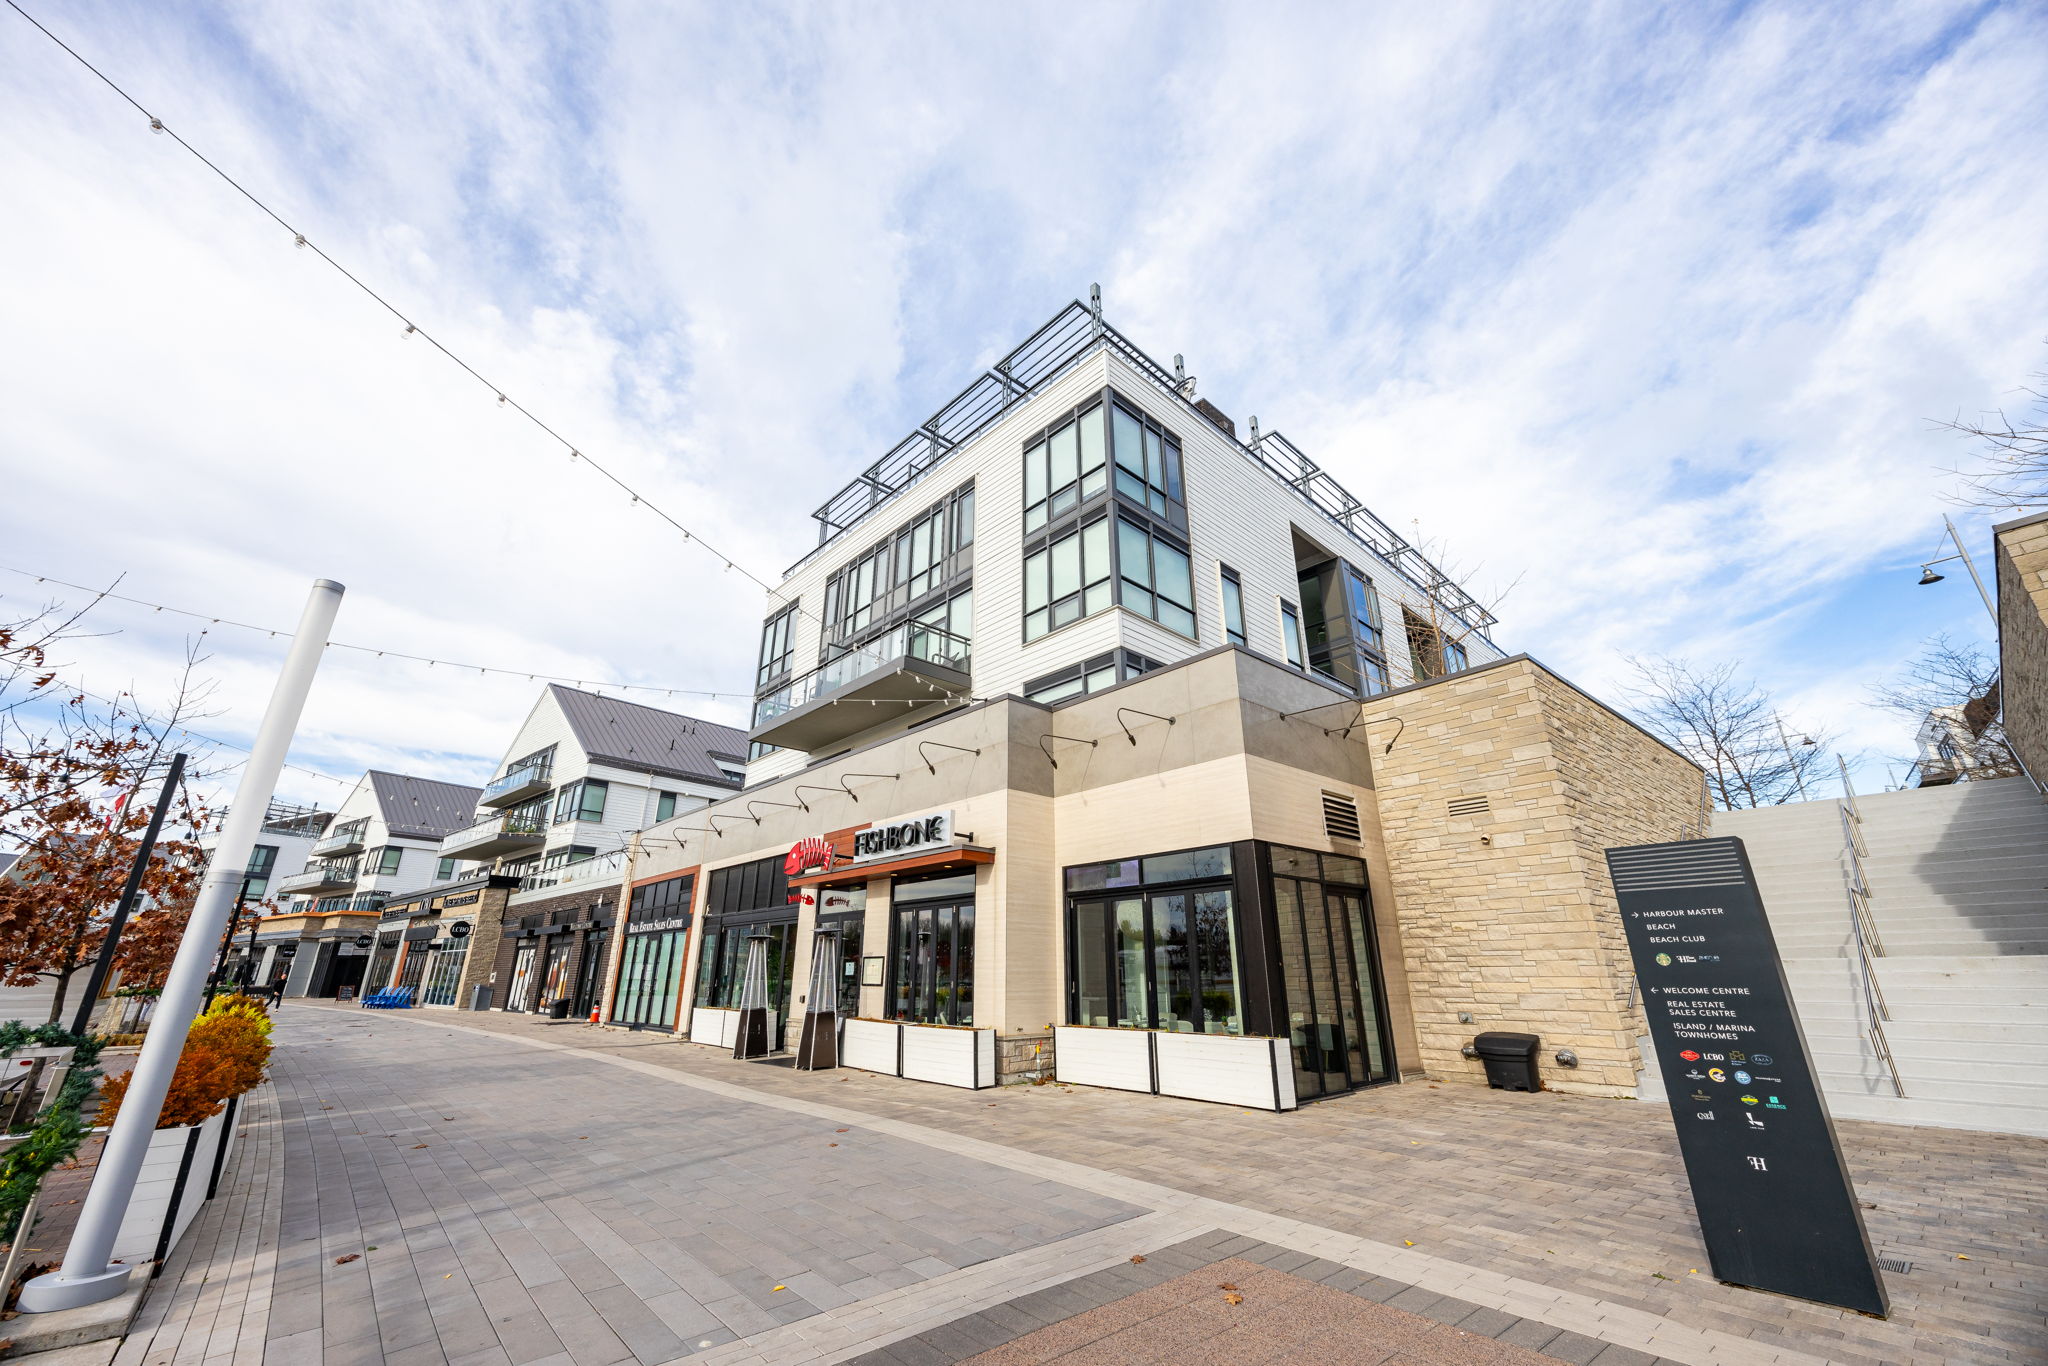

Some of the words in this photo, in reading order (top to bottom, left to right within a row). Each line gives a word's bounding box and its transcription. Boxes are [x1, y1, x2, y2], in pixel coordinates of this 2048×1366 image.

[854, 816, 943, 857] FISHBONE
[1642, 909, 1685, 918] HARBOUR
[1686, 907, 1724, 916] MASTER
[1646, 923, 1676, 931] BEACH
[1649, 936, 1680, 944] BEACH
[1681, 935, 1706, 943] CLUB
[1662, 987, 1710, 995] WELCOME
[1711, 987, 1751, 995] CENTRE
[1666, 1000, 1690, 1008] REAL
[1691, 1001, 1726, 1009] ESTATE
[1698, 1009, 1737, 1018] CENTRE
[1672, 1022, 1707, 1031] ISLAND
[1716, 1024, 1756, 1033] MARINA
[1674, 1031, 1739, 1041] TOWNHOMES
[1702, 1052, 1725, 1062] LCBO
